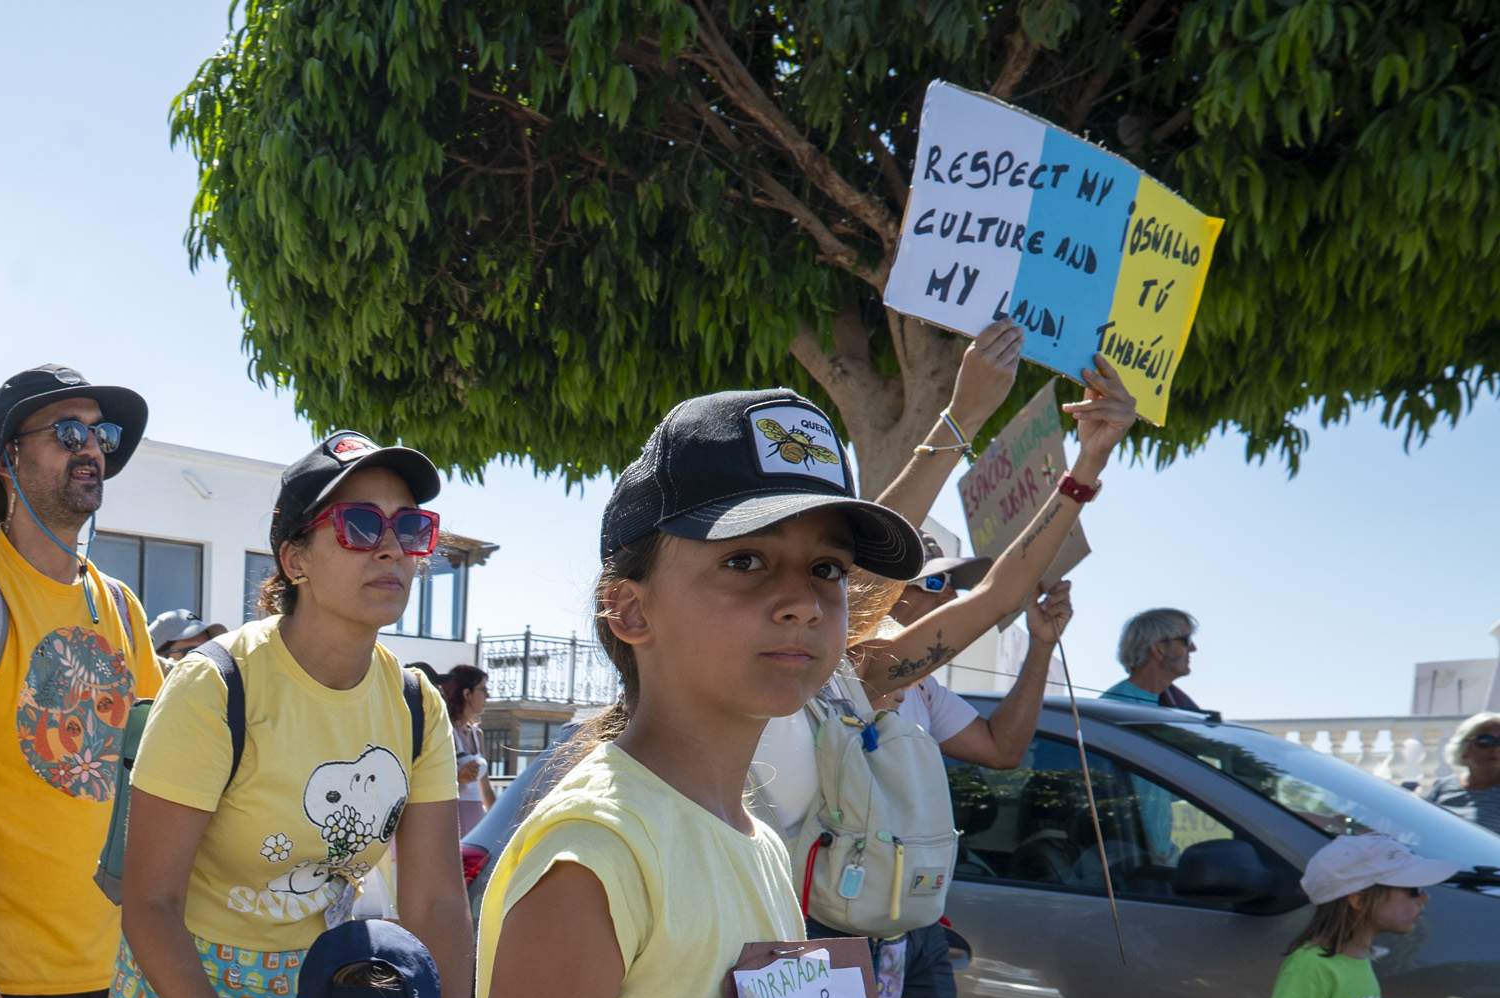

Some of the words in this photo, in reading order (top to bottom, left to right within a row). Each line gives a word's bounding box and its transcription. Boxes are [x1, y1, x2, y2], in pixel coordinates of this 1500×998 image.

[924, 145, 1070, 190] RESPECT
[1076, 168, 1115, 207] MY
[914, 208, 1046, 255] CULTURE
[1053, 236, 1098, 274] AND
[925, 262, 980, 306] MY
[992, 290, 1066, 348] LAND!
[1138, 279, 1175, 313] TÚ
[1096, 321, 1175, 396] TAMBIÉN!
[800, 419, 832, 437] QUEEN
